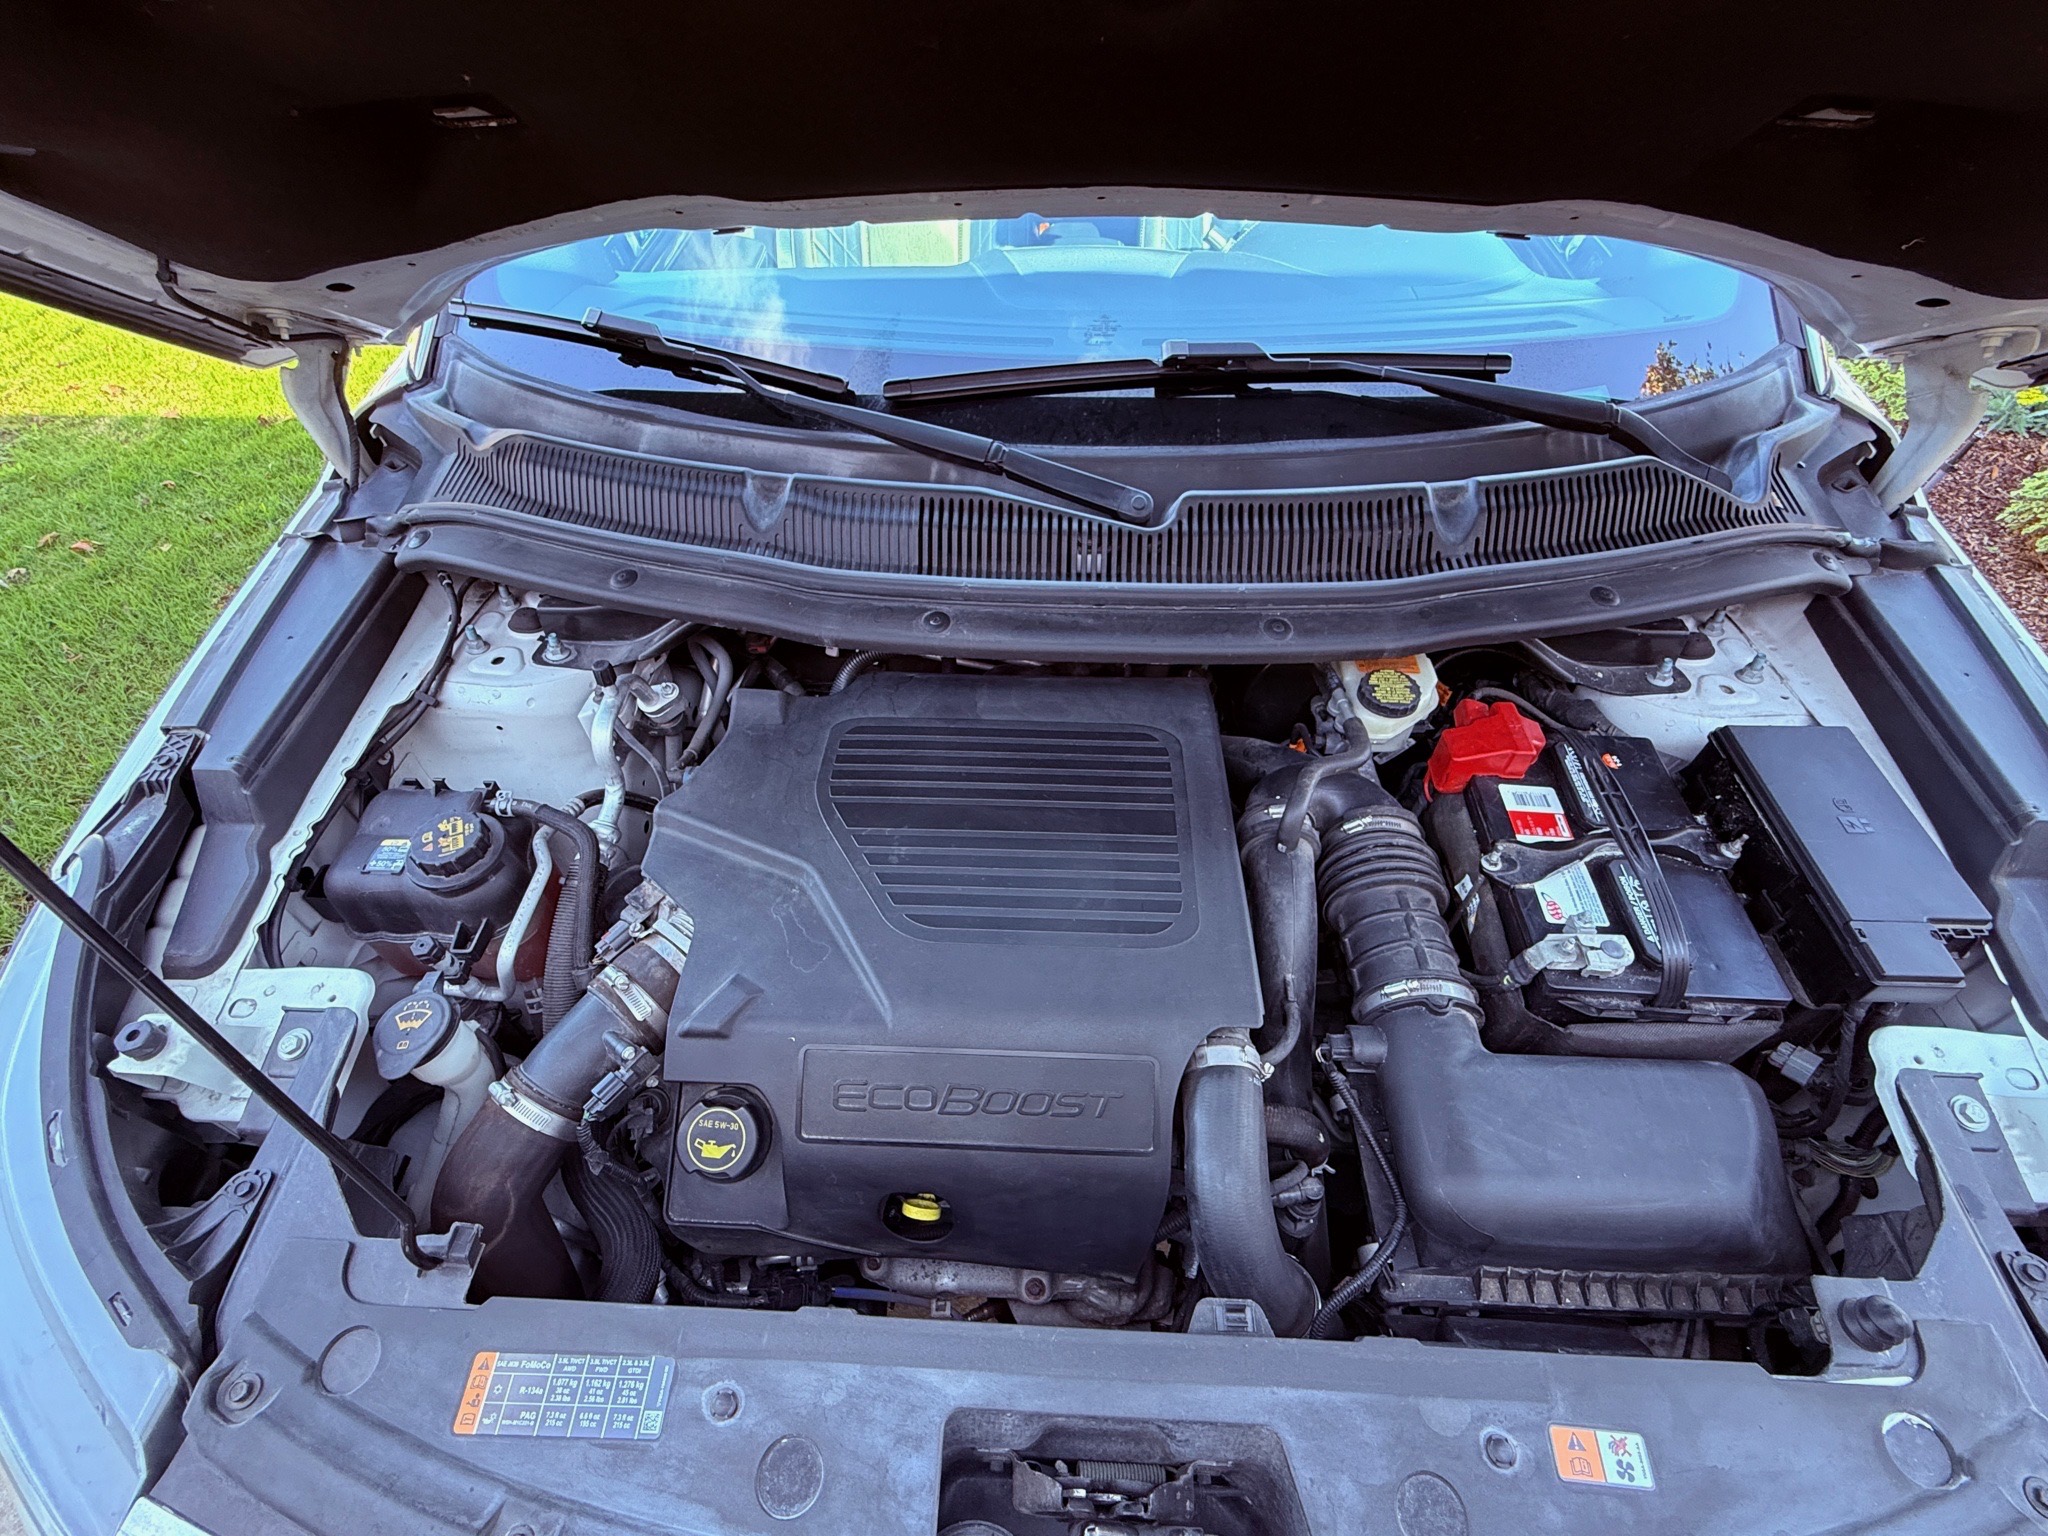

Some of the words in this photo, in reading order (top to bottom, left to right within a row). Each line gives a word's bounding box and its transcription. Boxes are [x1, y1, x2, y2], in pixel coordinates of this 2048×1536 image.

[699, 1119, 714, 1128] SAE
[714, 1120, 739, 1131] 5W-30
[520, 1360, 551, 1369] FoMoCo
[552, 1378, 569, 1386] 1.077
[569, 1379, 578, 1388] kg
[585, 1379, 602, 1387] 1.162
[602, 1380, 611, 1389] kg
[635, 1381, 644, 1391] kg
[519, 1386, 544, 1395] R-134a
[519, 1411, 537, 1420] PAG
